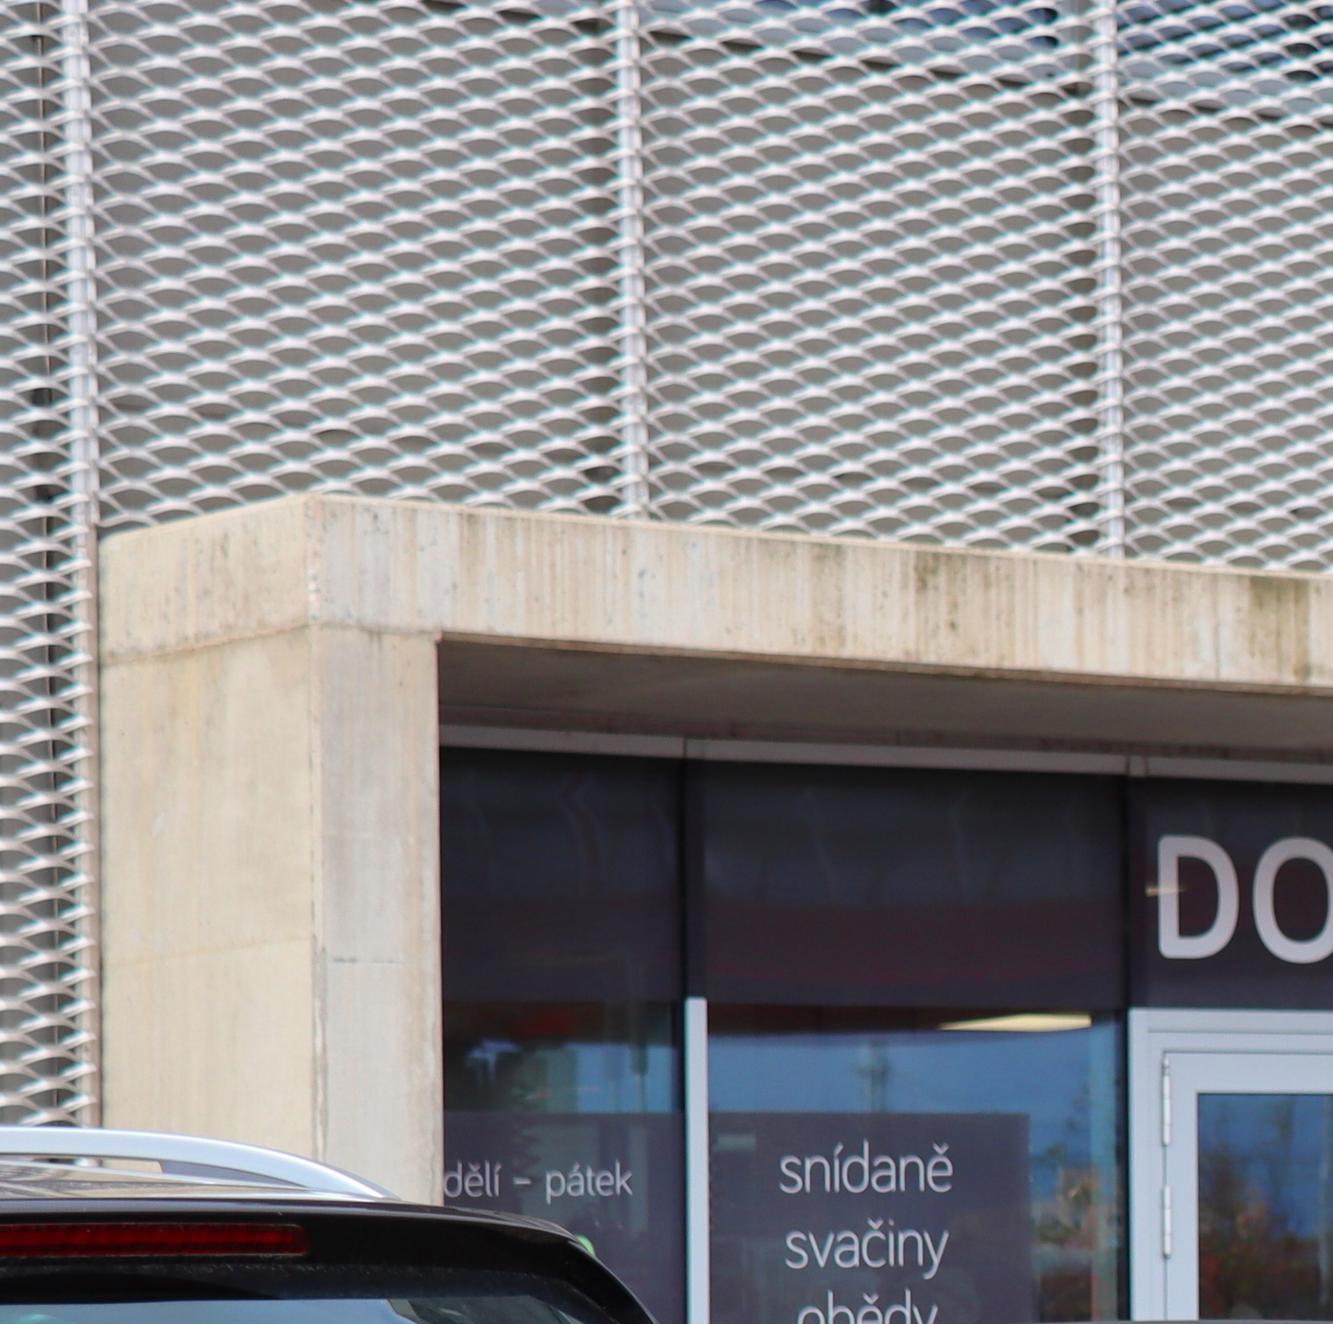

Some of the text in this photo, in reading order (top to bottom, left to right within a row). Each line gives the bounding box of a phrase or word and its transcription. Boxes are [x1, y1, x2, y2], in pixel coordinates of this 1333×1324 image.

[545, 1159, 634, 1206] pátek
[778, 1137, 954, 1195] snídaně
[784, 1216, 950, 1281] svačiny
